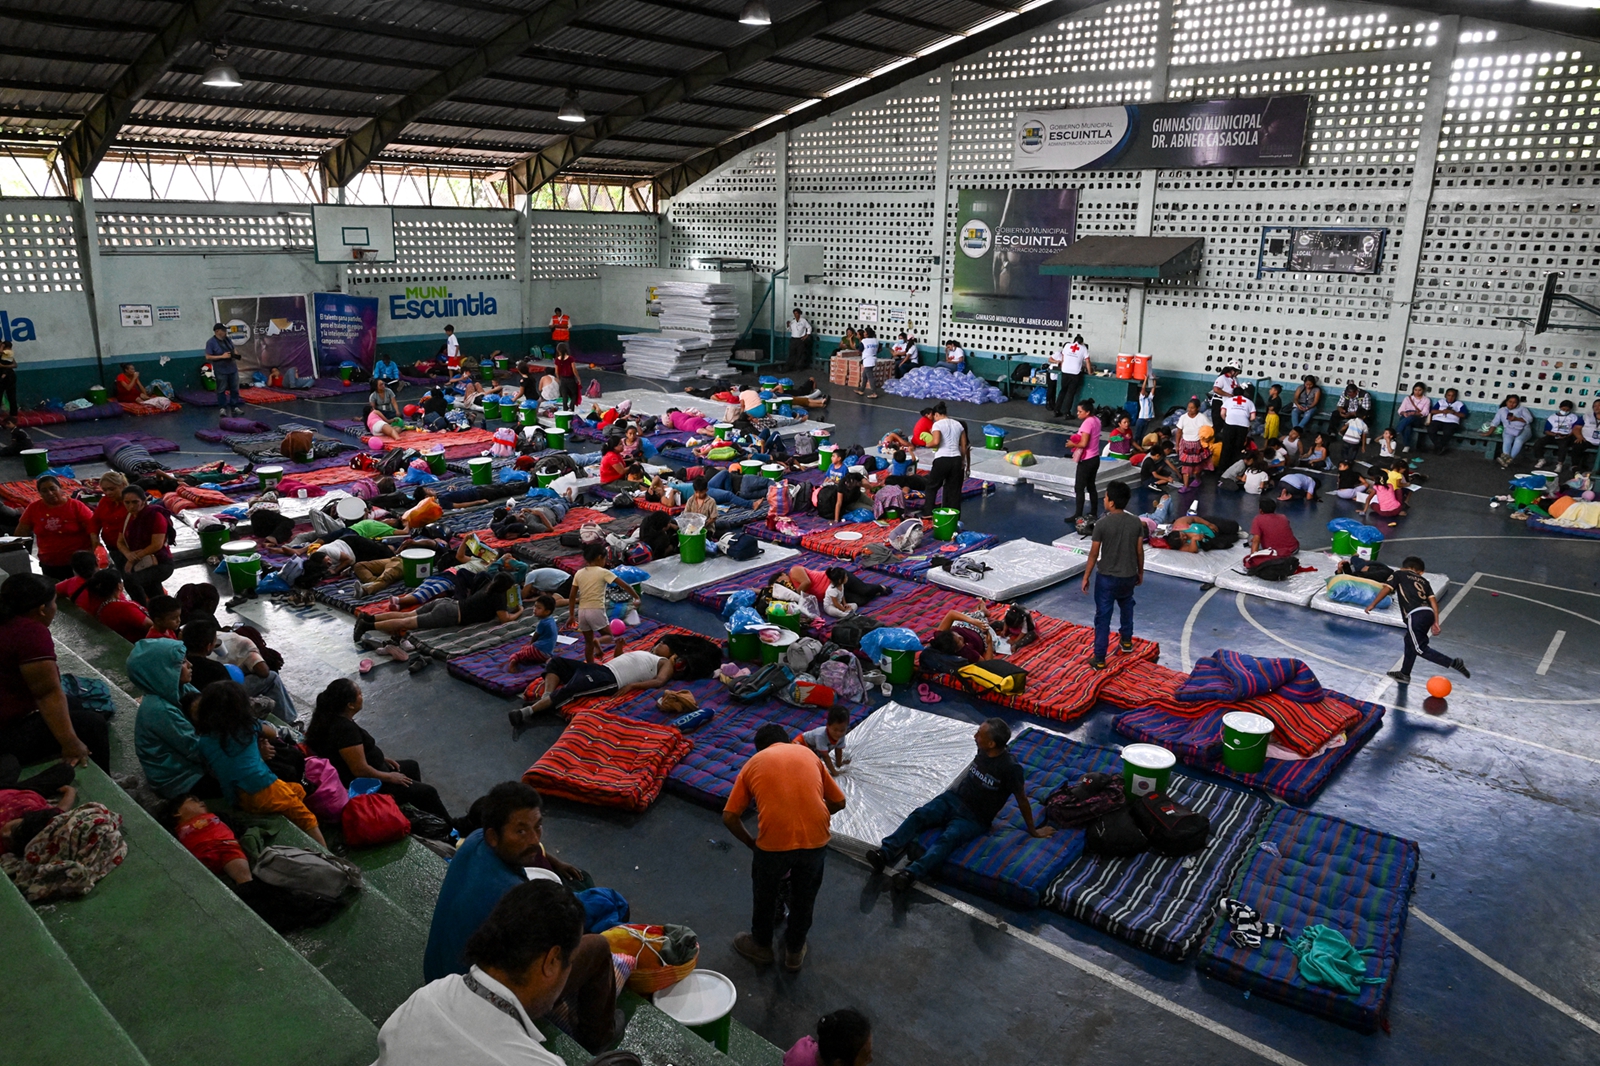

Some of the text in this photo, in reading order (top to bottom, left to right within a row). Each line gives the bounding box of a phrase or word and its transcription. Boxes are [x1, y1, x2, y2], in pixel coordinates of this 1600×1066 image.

[1152, 113, 1262, 133] GIMNASIO MUNICIPAL
[1049, 129, 1113, 141] ESCUINTLA
[1151, 130, 1259, 149] DR. ABNER CASASOLA
[1031, 226, 1069, 235] MUNICIPAL
[994, 235, 1068, 247] ESCUINTLA
[405, 285, 448, 299] MUNI
[389, 291, 498, 320] Escuintla
[0, 310, 37, 343] la
[1026, 317, 1041, 326] ABNER
[1041, 319, 1063, 327] CASASOLA
[1413, 581, 1428, 600] 9
[969, 766, 995, 787] JORDAN
